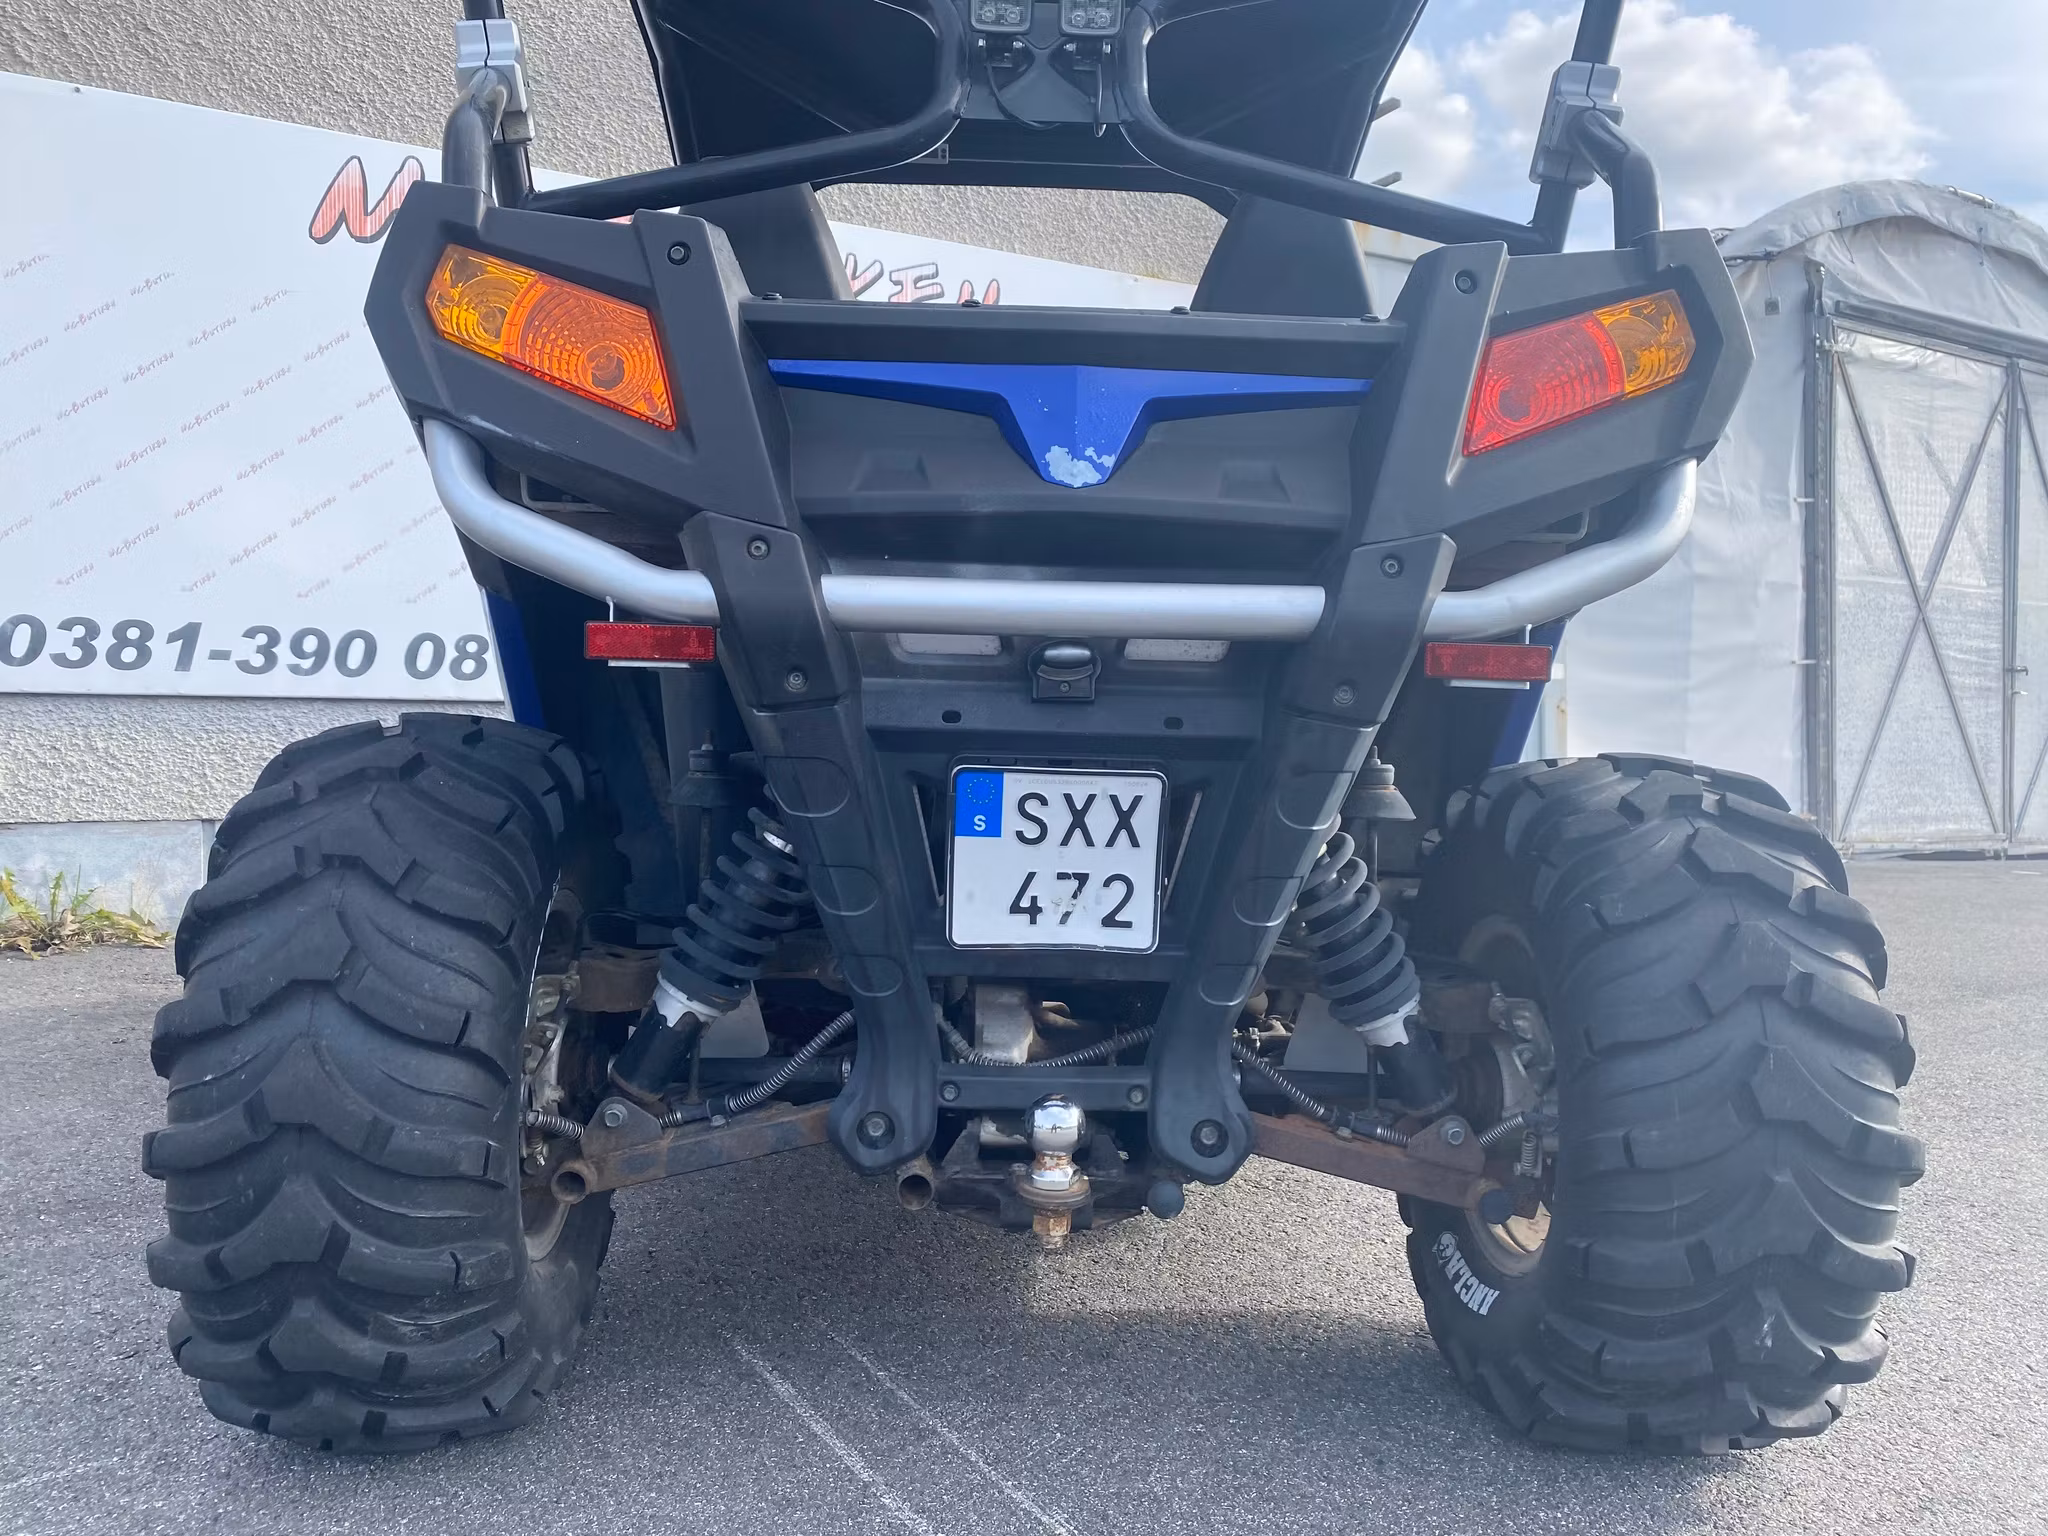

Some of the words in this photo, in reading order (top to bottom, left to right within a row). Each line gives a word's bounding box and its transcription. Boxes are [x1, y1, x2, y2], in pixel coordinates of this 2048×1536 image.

[0, 614, 378, 678] 0381-390
[404, 632, 490, 681] 08
[973, 814, 987, 832] S
[1015, 792, 1144, 848] SXX
[1009, 871, 1134, 929] 472
[1444, 1249, 1500, 1316] ANCLA
